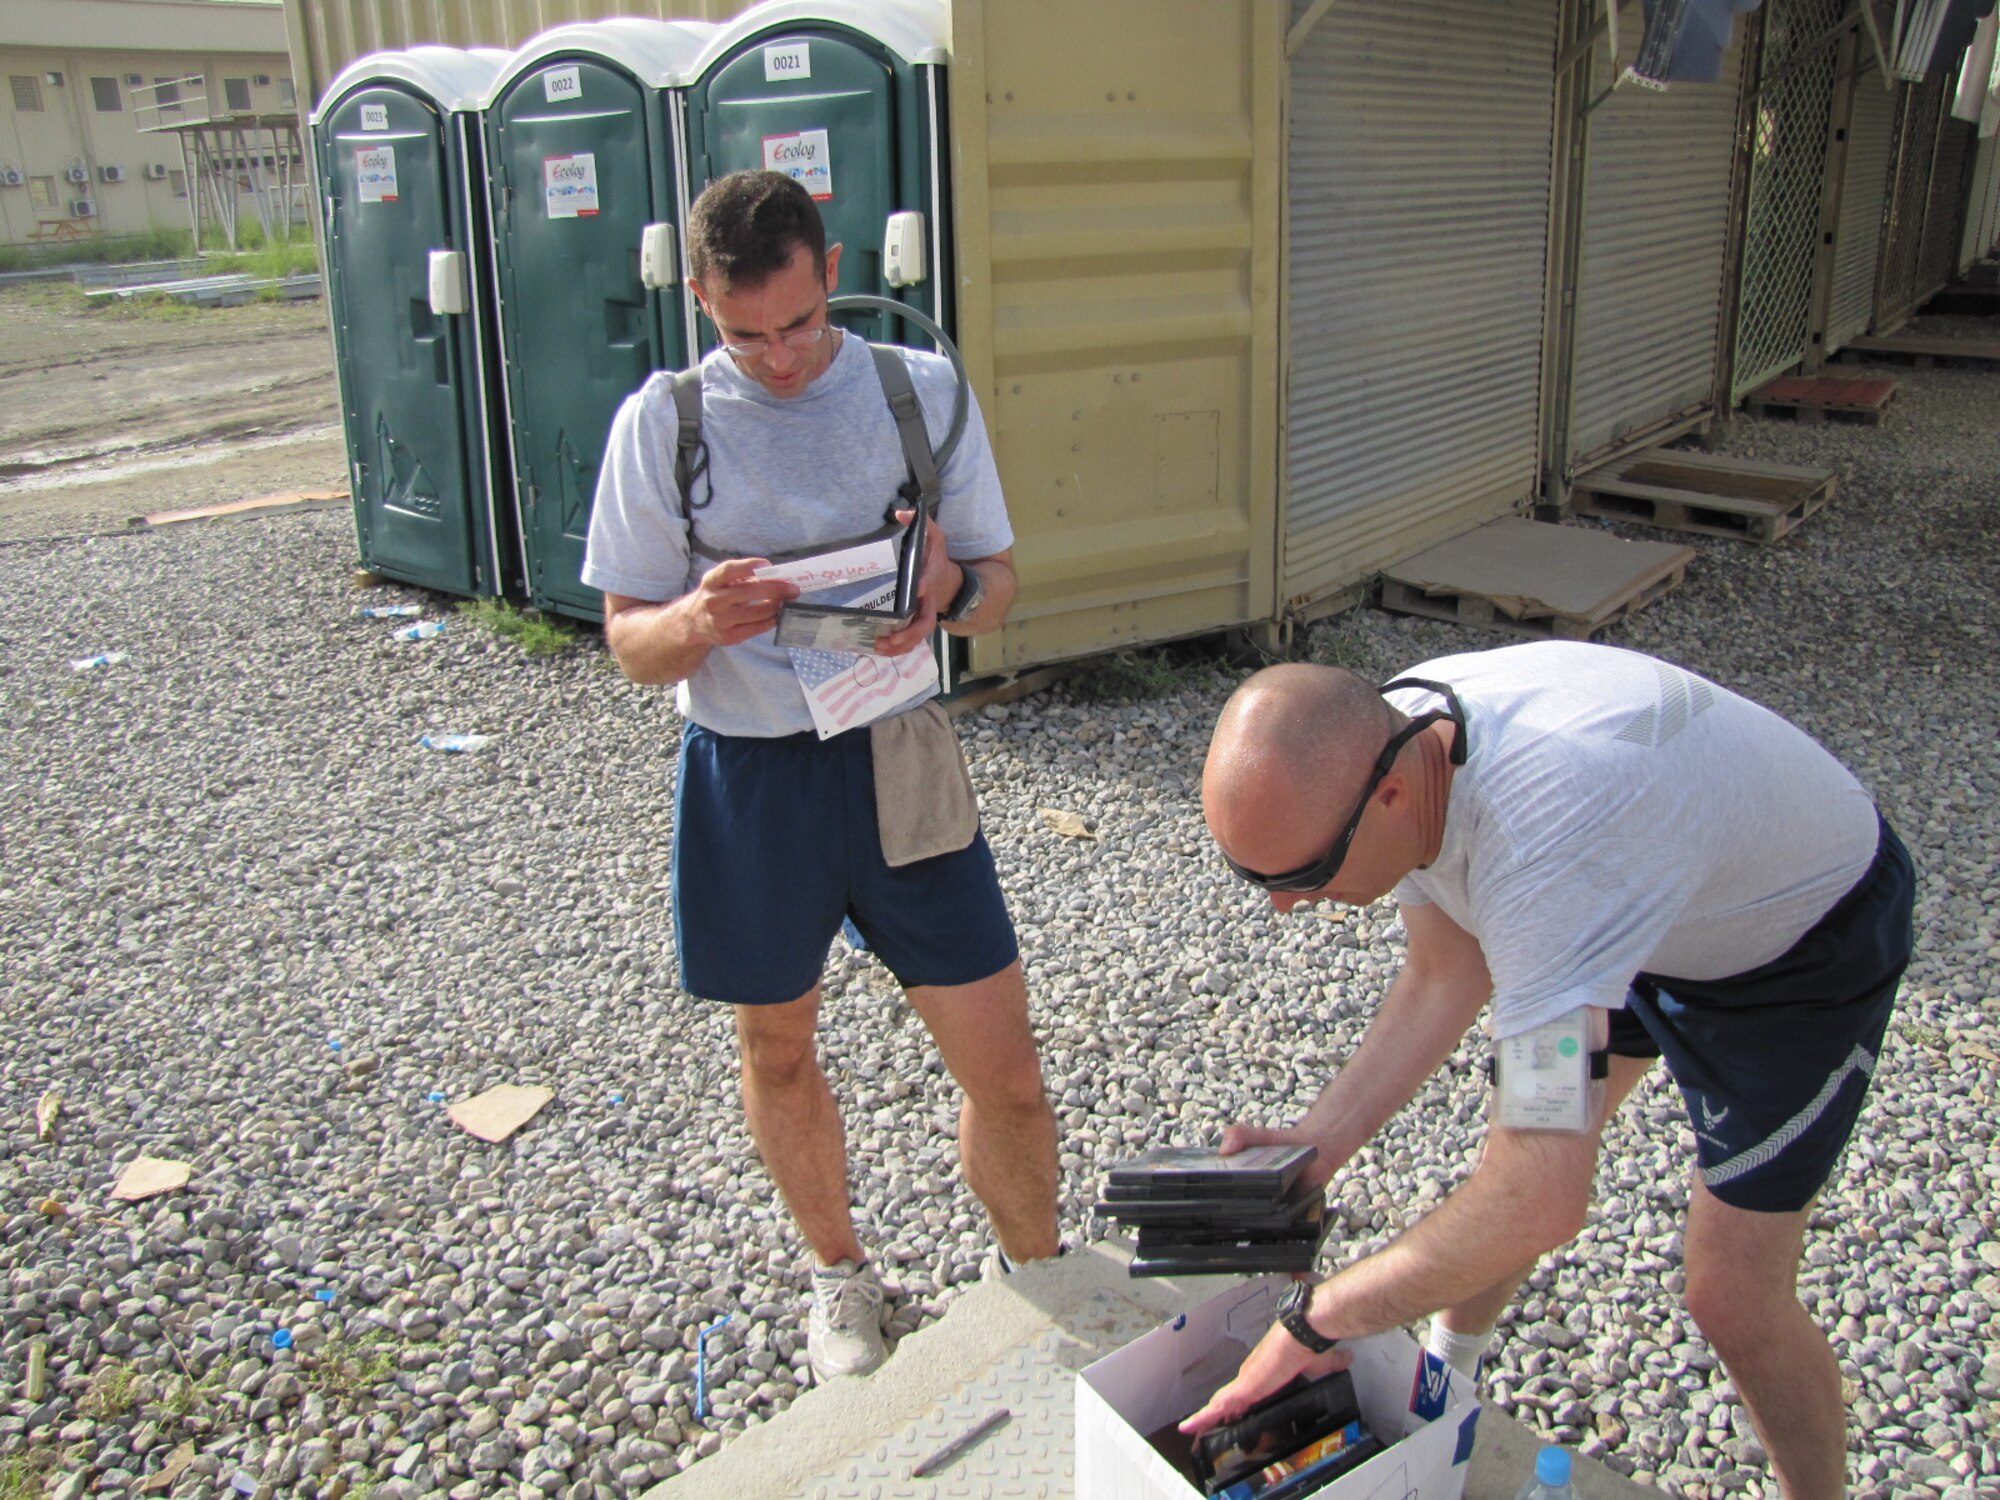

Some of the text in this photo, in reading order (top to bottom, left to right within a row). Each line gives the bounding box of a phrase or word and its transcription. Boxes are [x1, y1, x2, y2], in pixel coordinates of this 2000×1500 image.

[774, 54, 801, 71] 0021
[551, 76, 574, 92] 0022
[365, 111, 384, 123] 0023
[774, 140, 815, 160] Ecolog
[362, 153, 388, 170] Ecolog
[553, 162, 586, 180] Ecolog
[861, 589, 896, 611] OULDER
